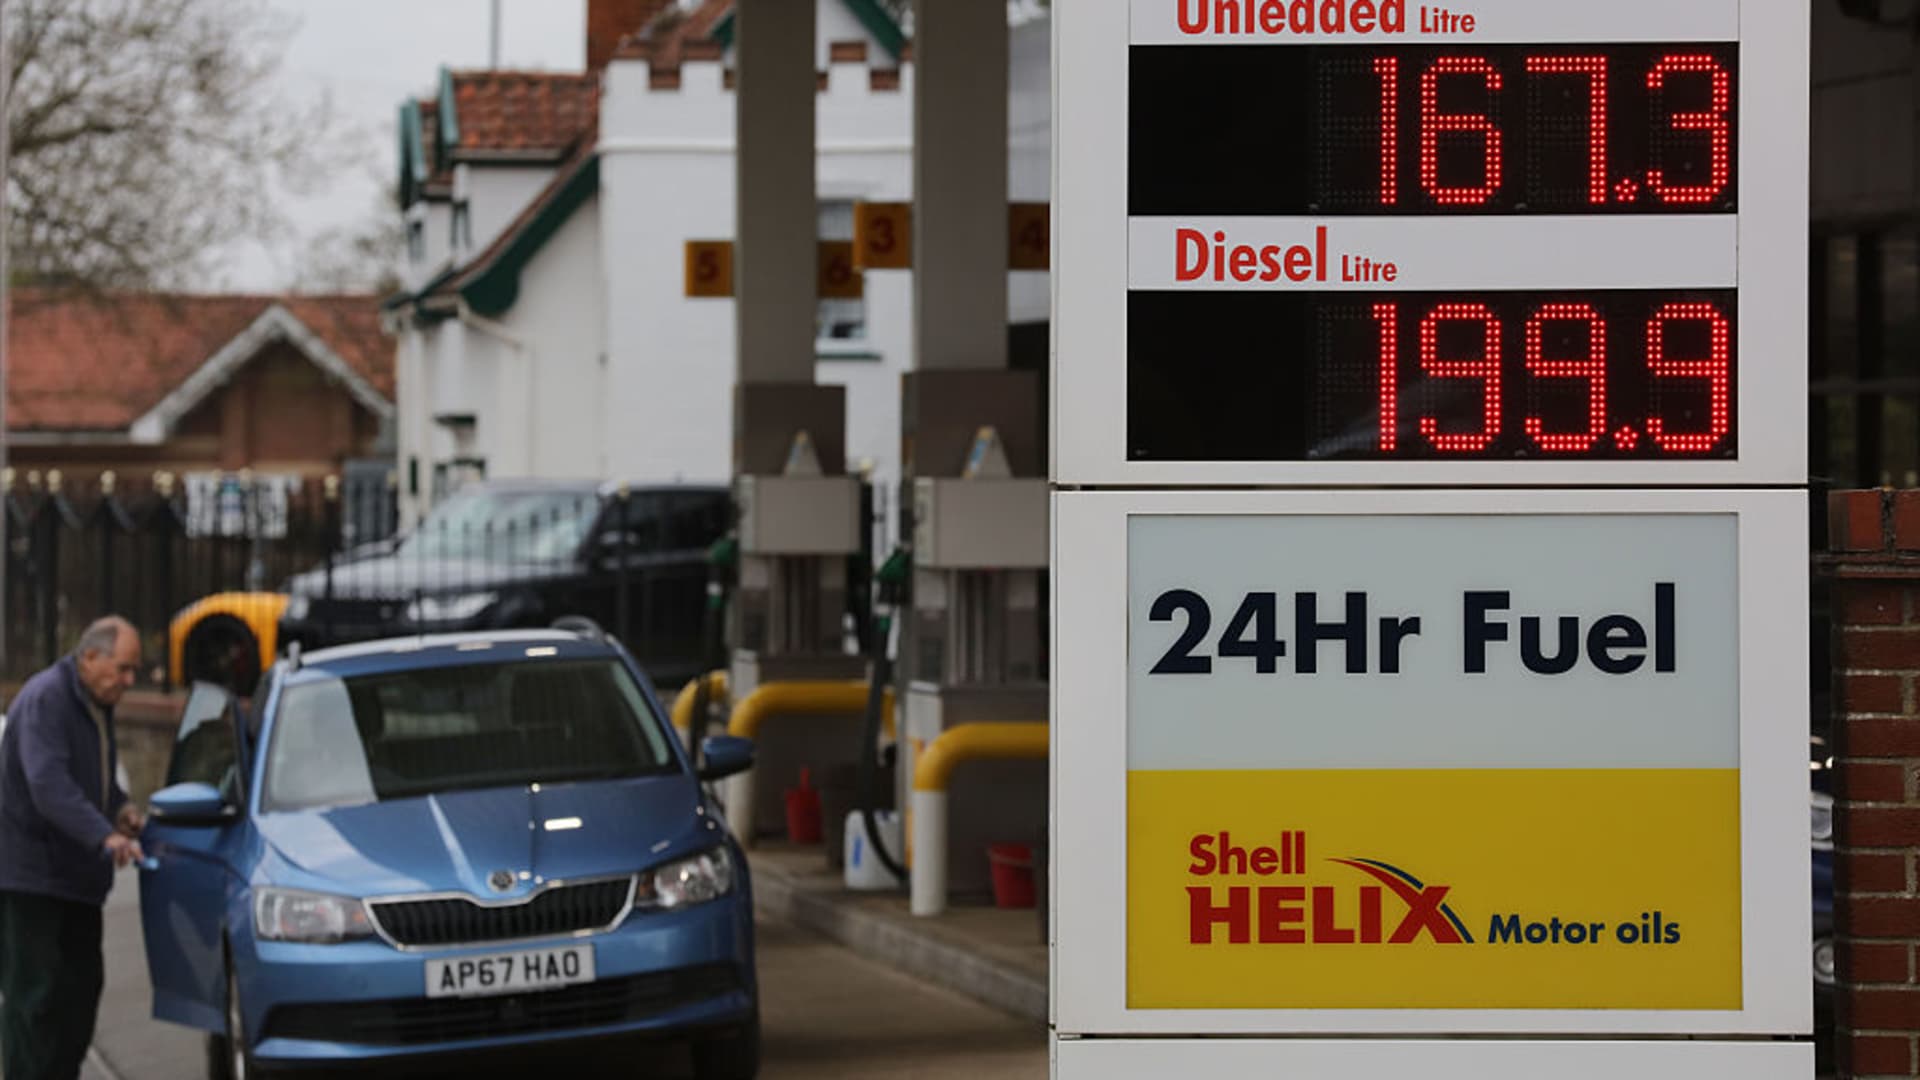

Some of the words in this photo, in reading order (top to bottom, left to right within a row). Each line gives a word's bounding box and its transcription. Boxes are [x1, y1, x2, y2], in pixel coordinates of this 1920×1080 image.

[1420, 5, 1475, 34] Litre
[1373, 55, 1729, 204] 167.3
[869, 217, 894, 253] 3
[1175, 226, 1328, 283] Diesel
[1341, 255, 1397, 283] Litre
[694, 249, 720, 284] 5
[1373, 303, 1729, 452] 199.9
[1148, 588, 1421, 675] 24Hr
[1463, 581, 1676, 676] Fuel
[1188, 830, 1306, 876] Shell
[1186, 868, 1466, 945] HELIX
[1487, 914, 1606, 945] Motor
[1615, 911, 1681, 945] oils
[440, 957, 514, 990] AP67
